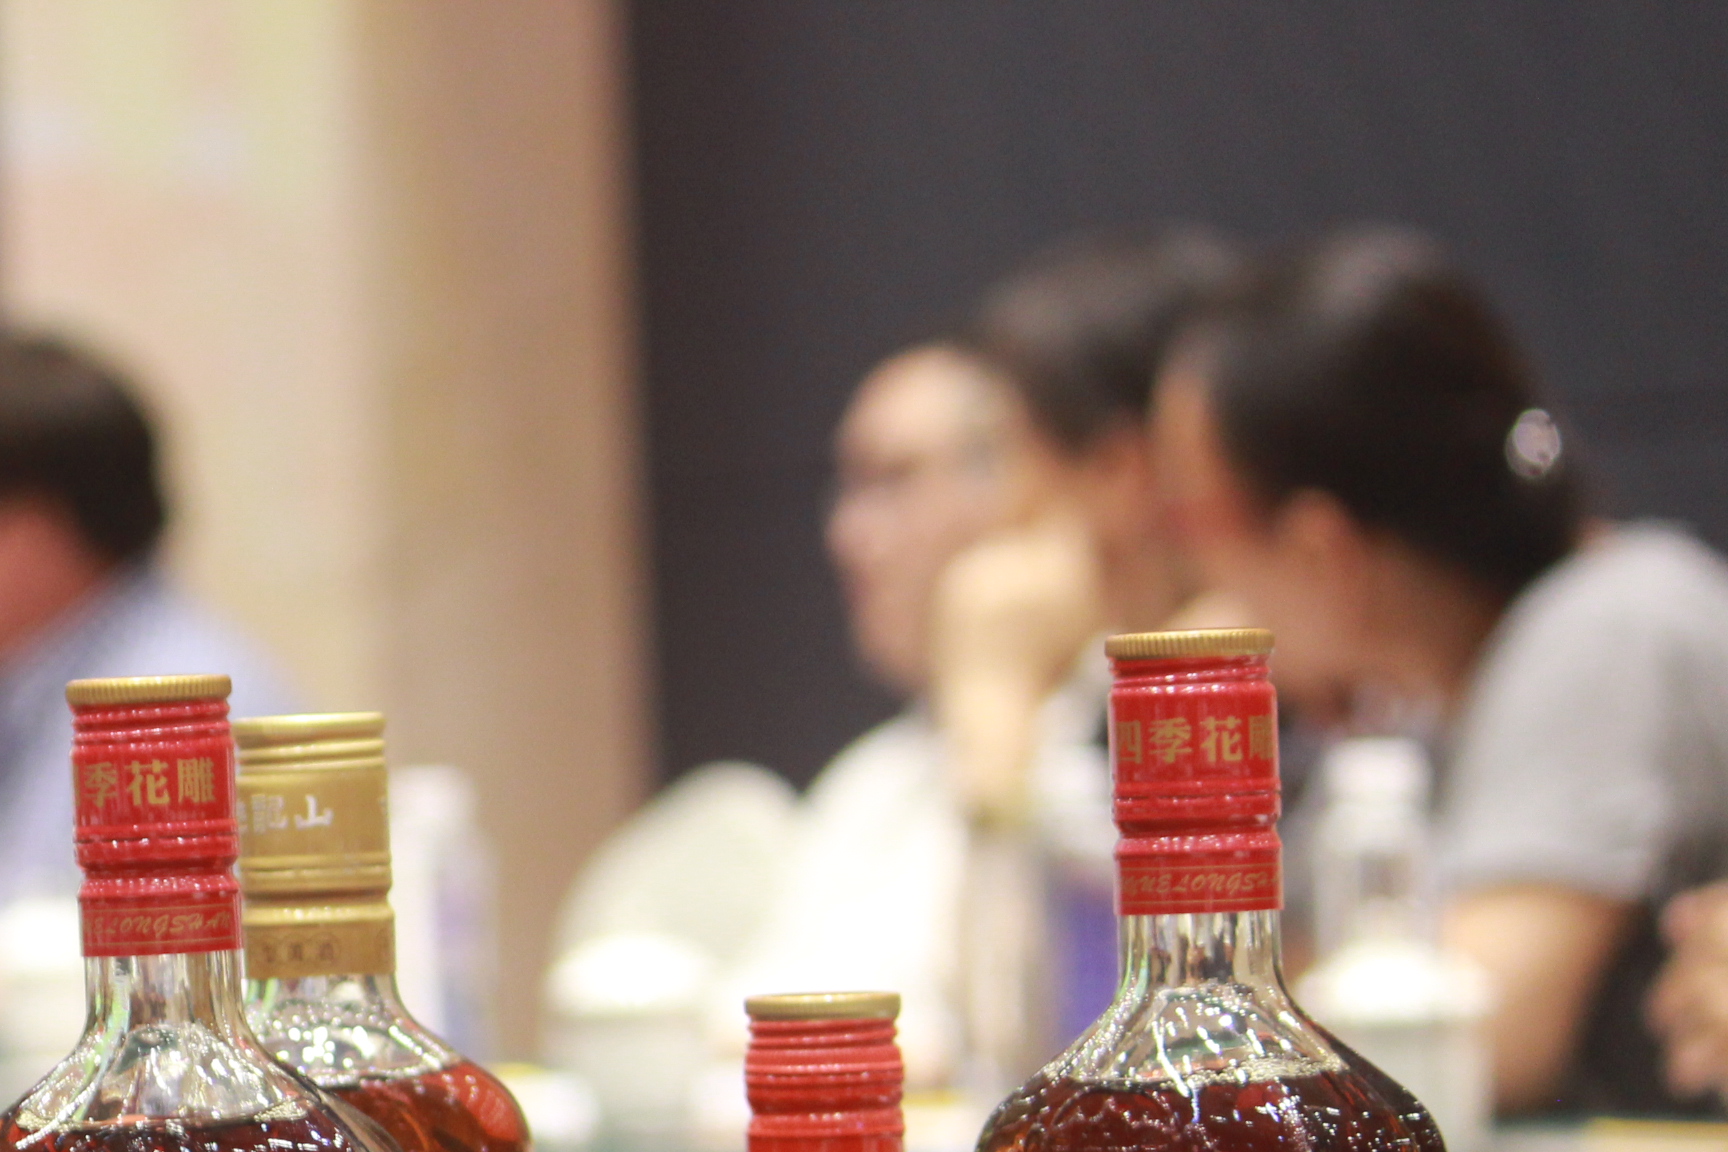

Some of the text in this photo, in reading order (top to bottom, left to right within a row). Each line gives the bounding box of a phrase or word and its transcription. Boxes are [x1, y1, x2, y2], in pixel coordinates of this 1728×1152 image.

[72, 757, 215, 808] 季花雕
[236, 794, 334, 835] 龍山
